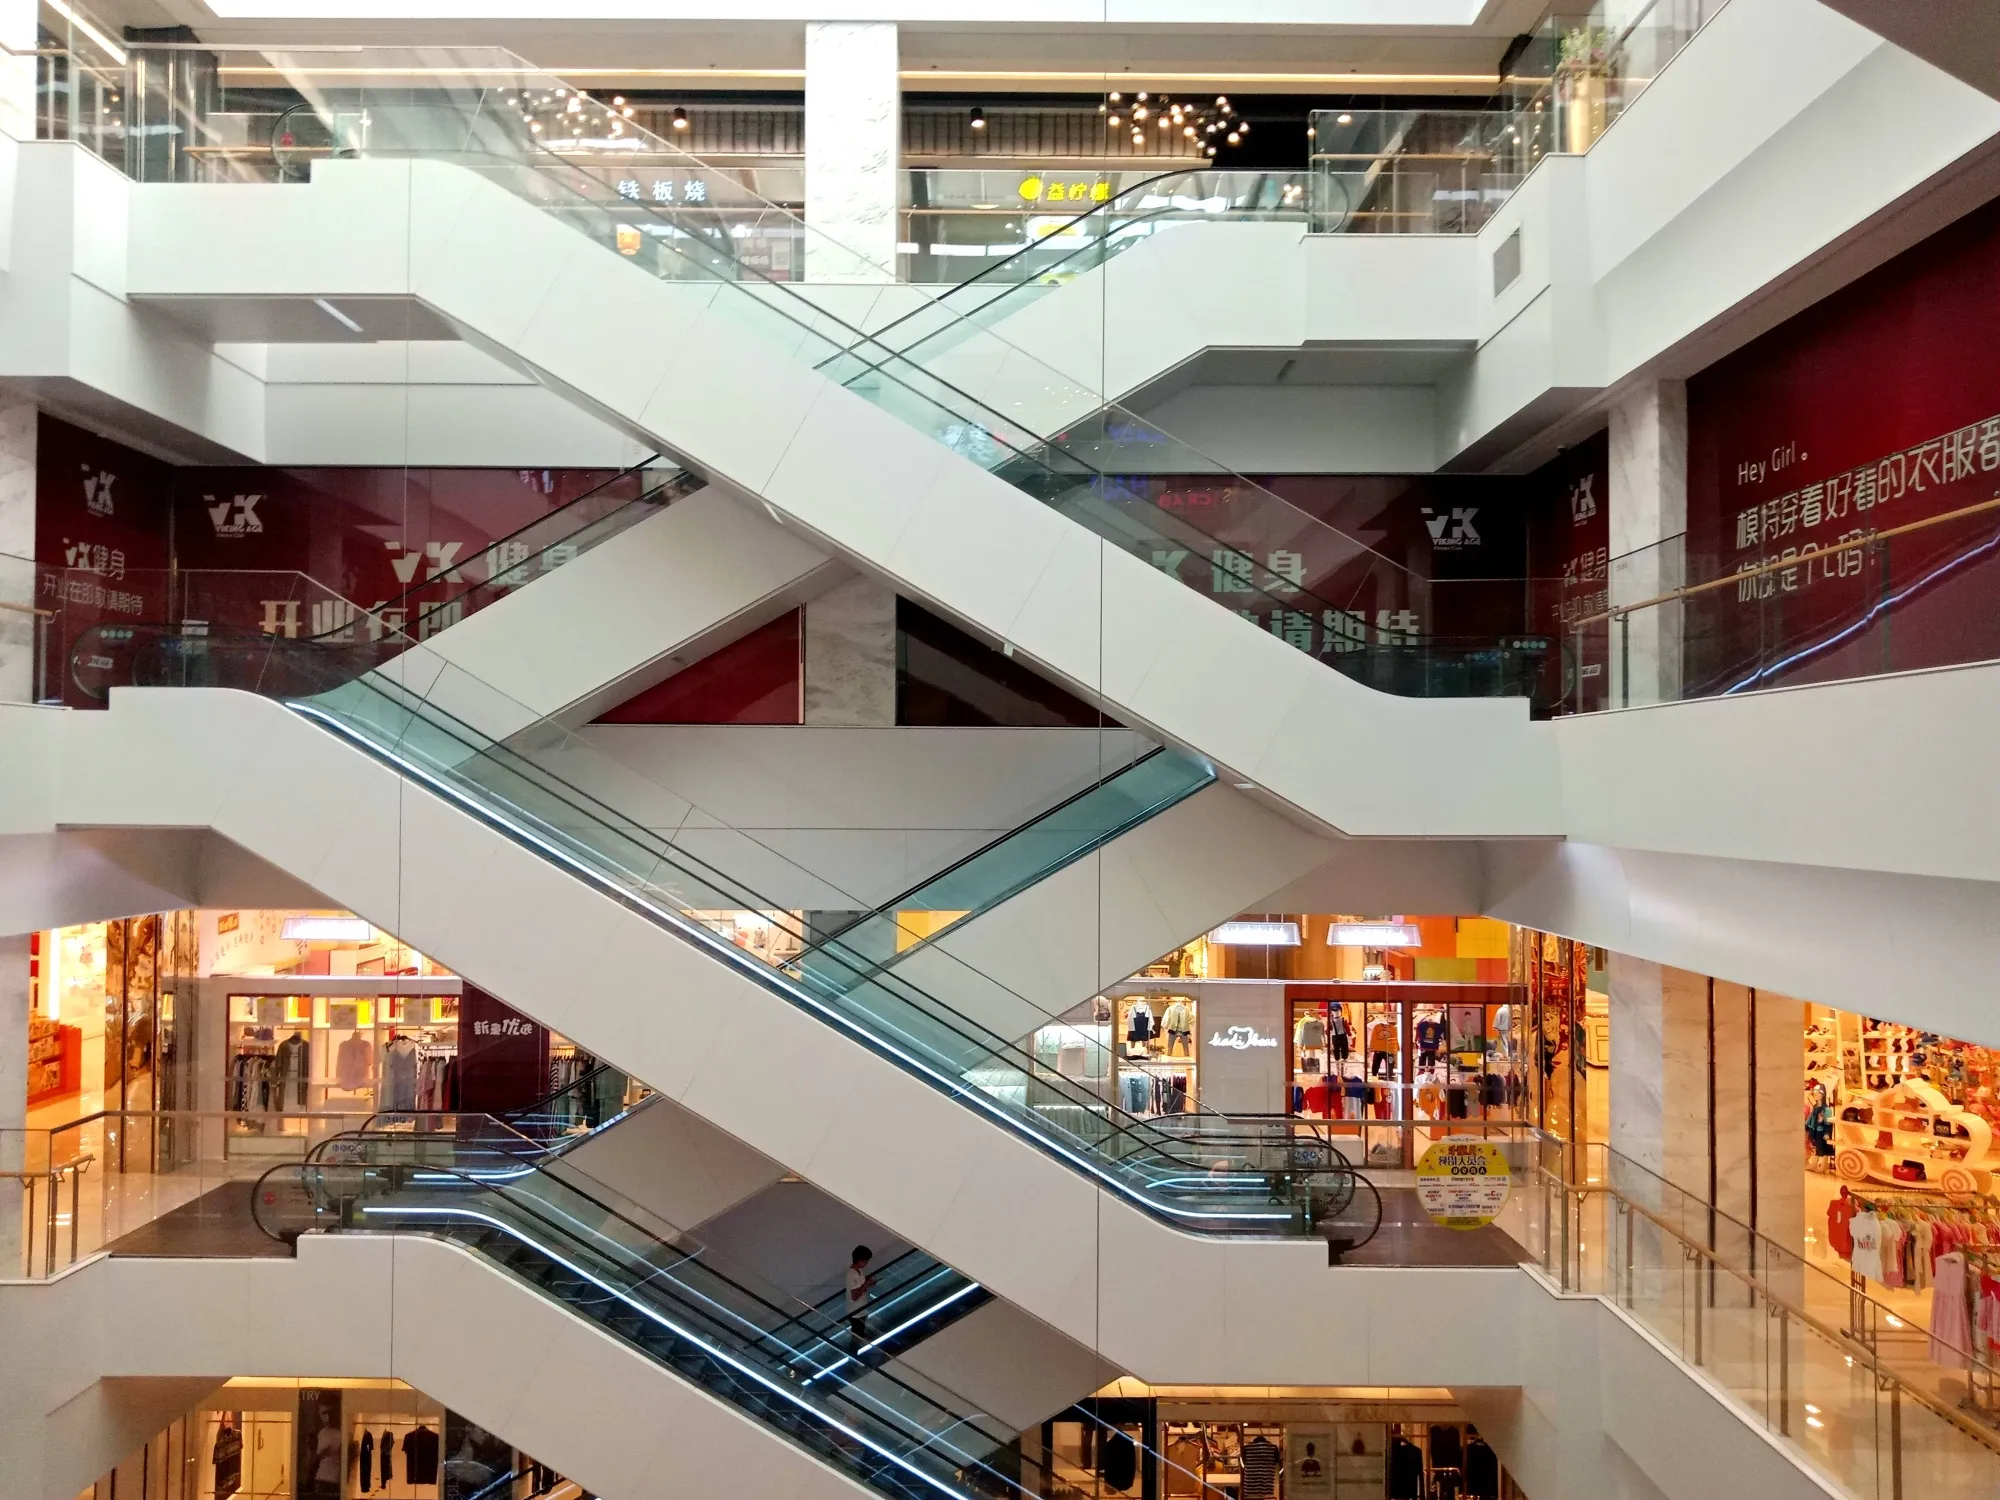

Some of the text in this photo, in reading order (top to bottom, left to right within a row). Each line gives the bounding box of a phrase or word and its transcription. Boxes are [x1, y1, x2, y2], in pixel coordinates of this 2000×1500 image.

[617, 179, 706, 201] 铁板烧
[1738, 459, 1766, 485] Hey
[1420, 507, 1480, 541] VK
[1229, 609, 1419, 653] 请期待
